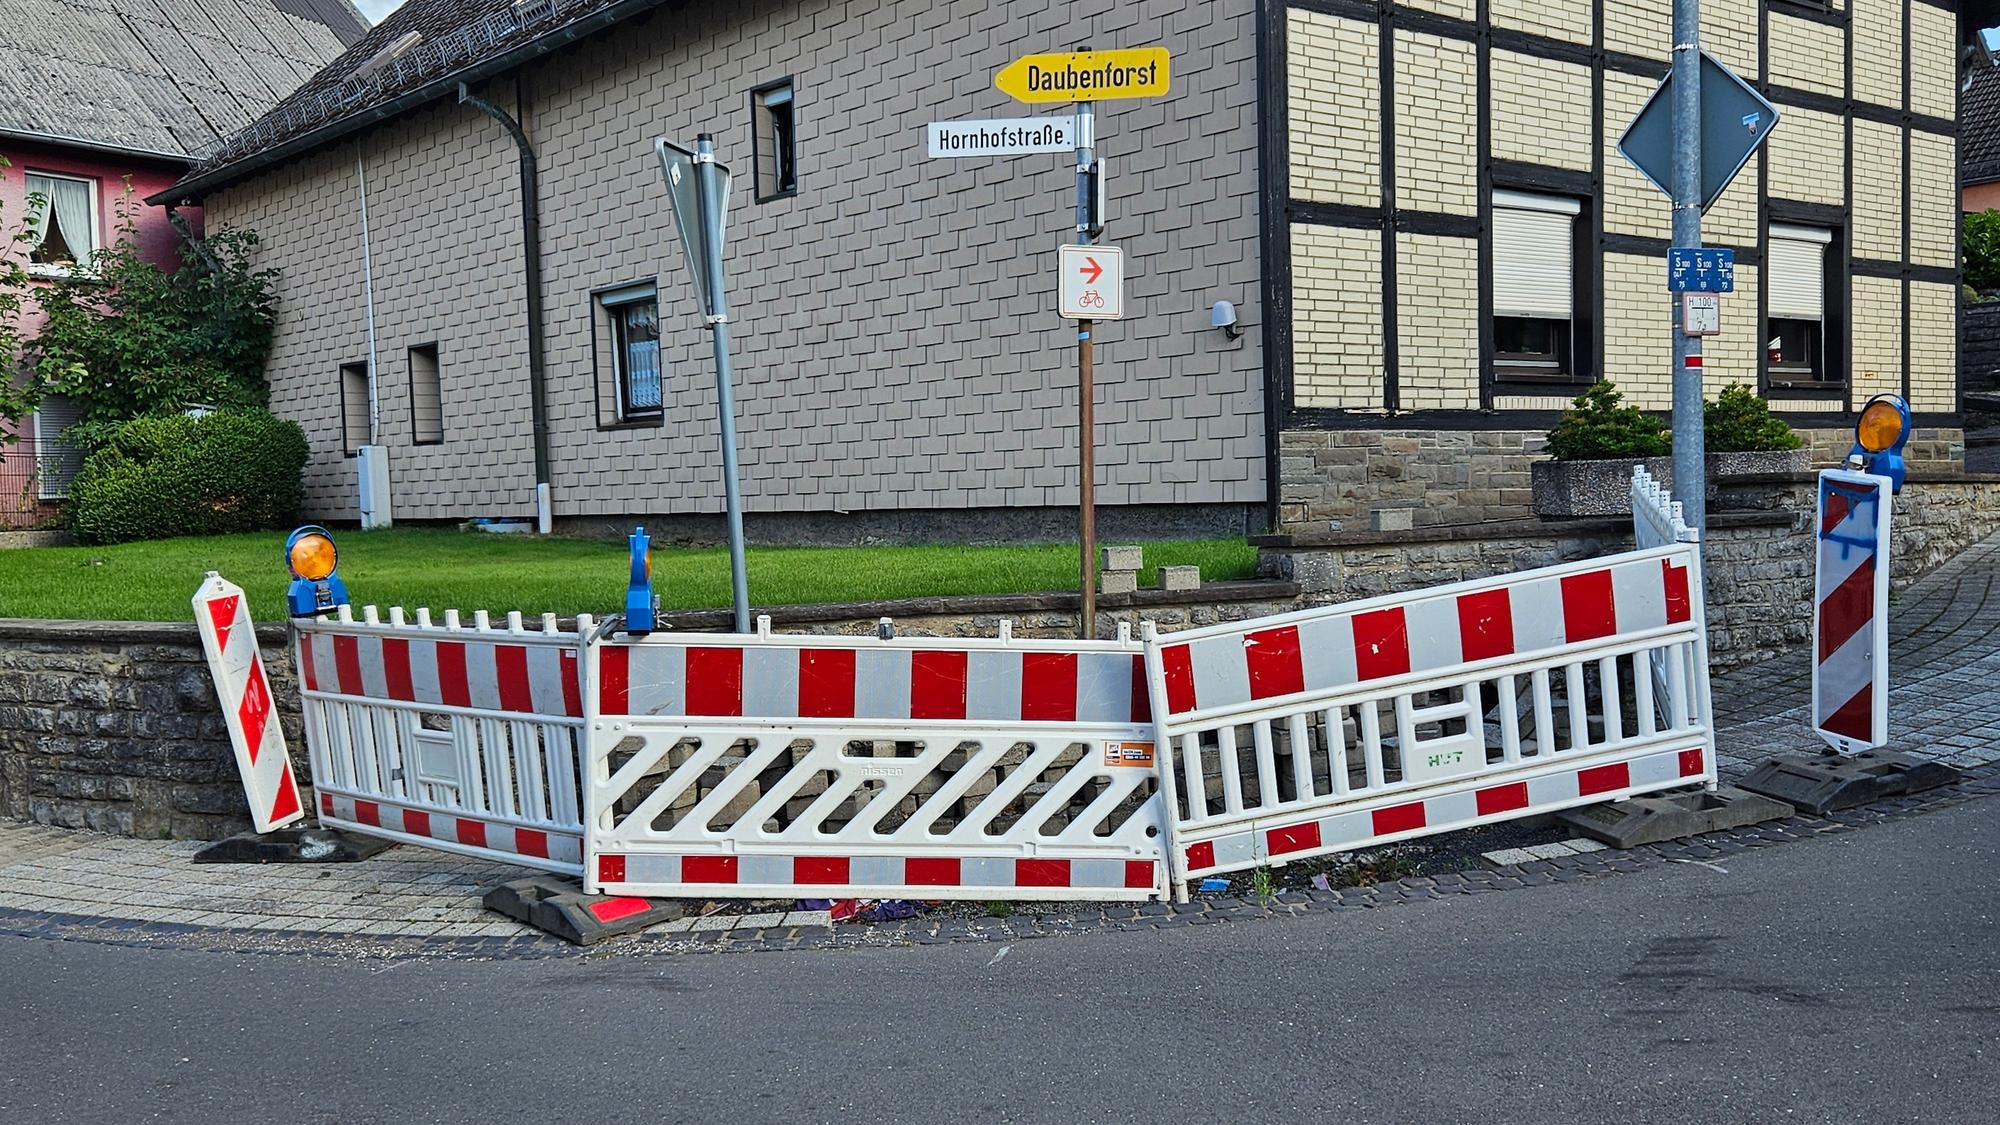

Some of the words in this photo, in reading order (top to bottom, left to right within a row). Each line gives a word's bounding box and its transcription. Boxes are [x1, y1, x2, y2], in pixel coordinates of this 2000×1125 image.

[1028, 59, 1157, 91] Daubenforst
[939, 124, 1064, 150] Hornhofstraße
[1676, 257, 1681, 268] S
[1697, 257, 1702, 268] S
[1718, 258, 1724, 268] S
[860, 762, 904, 776] nissen
